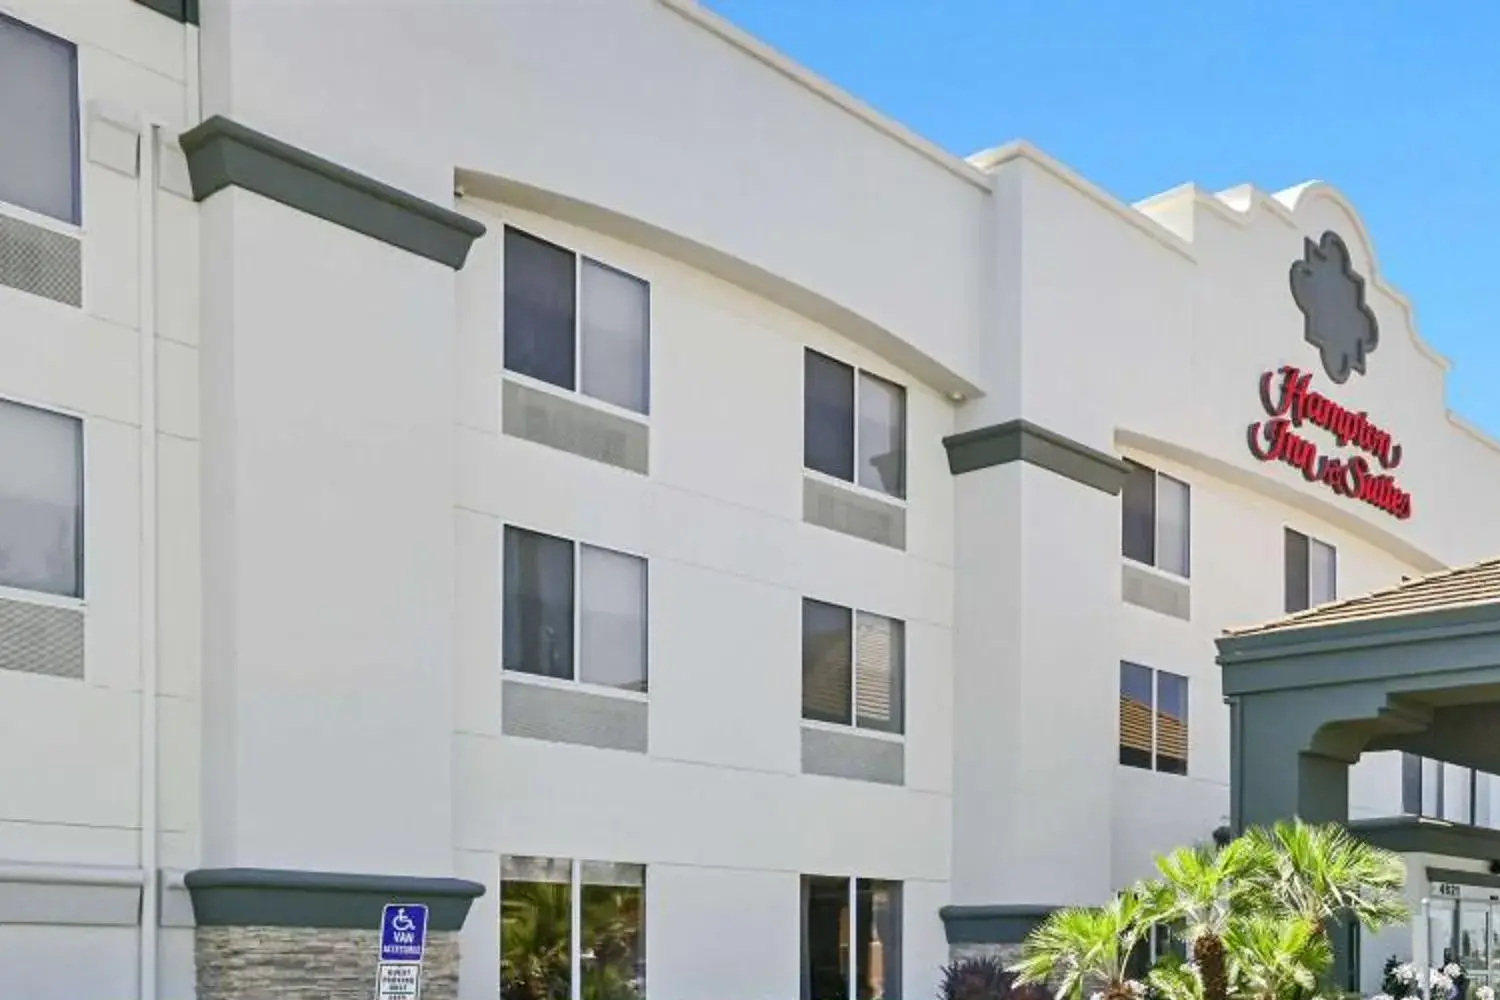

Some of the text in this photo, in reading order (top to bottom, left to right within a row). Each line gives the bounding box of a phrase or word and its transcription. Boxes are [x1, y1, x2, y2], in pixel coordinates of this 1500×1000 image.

[1259, 366, 1402, 469] Hampton
[1247, 420, 1328, 482] Inn
[1345, 455, 1412, 521] Suites
[393, 931, 415, 943] VAN
